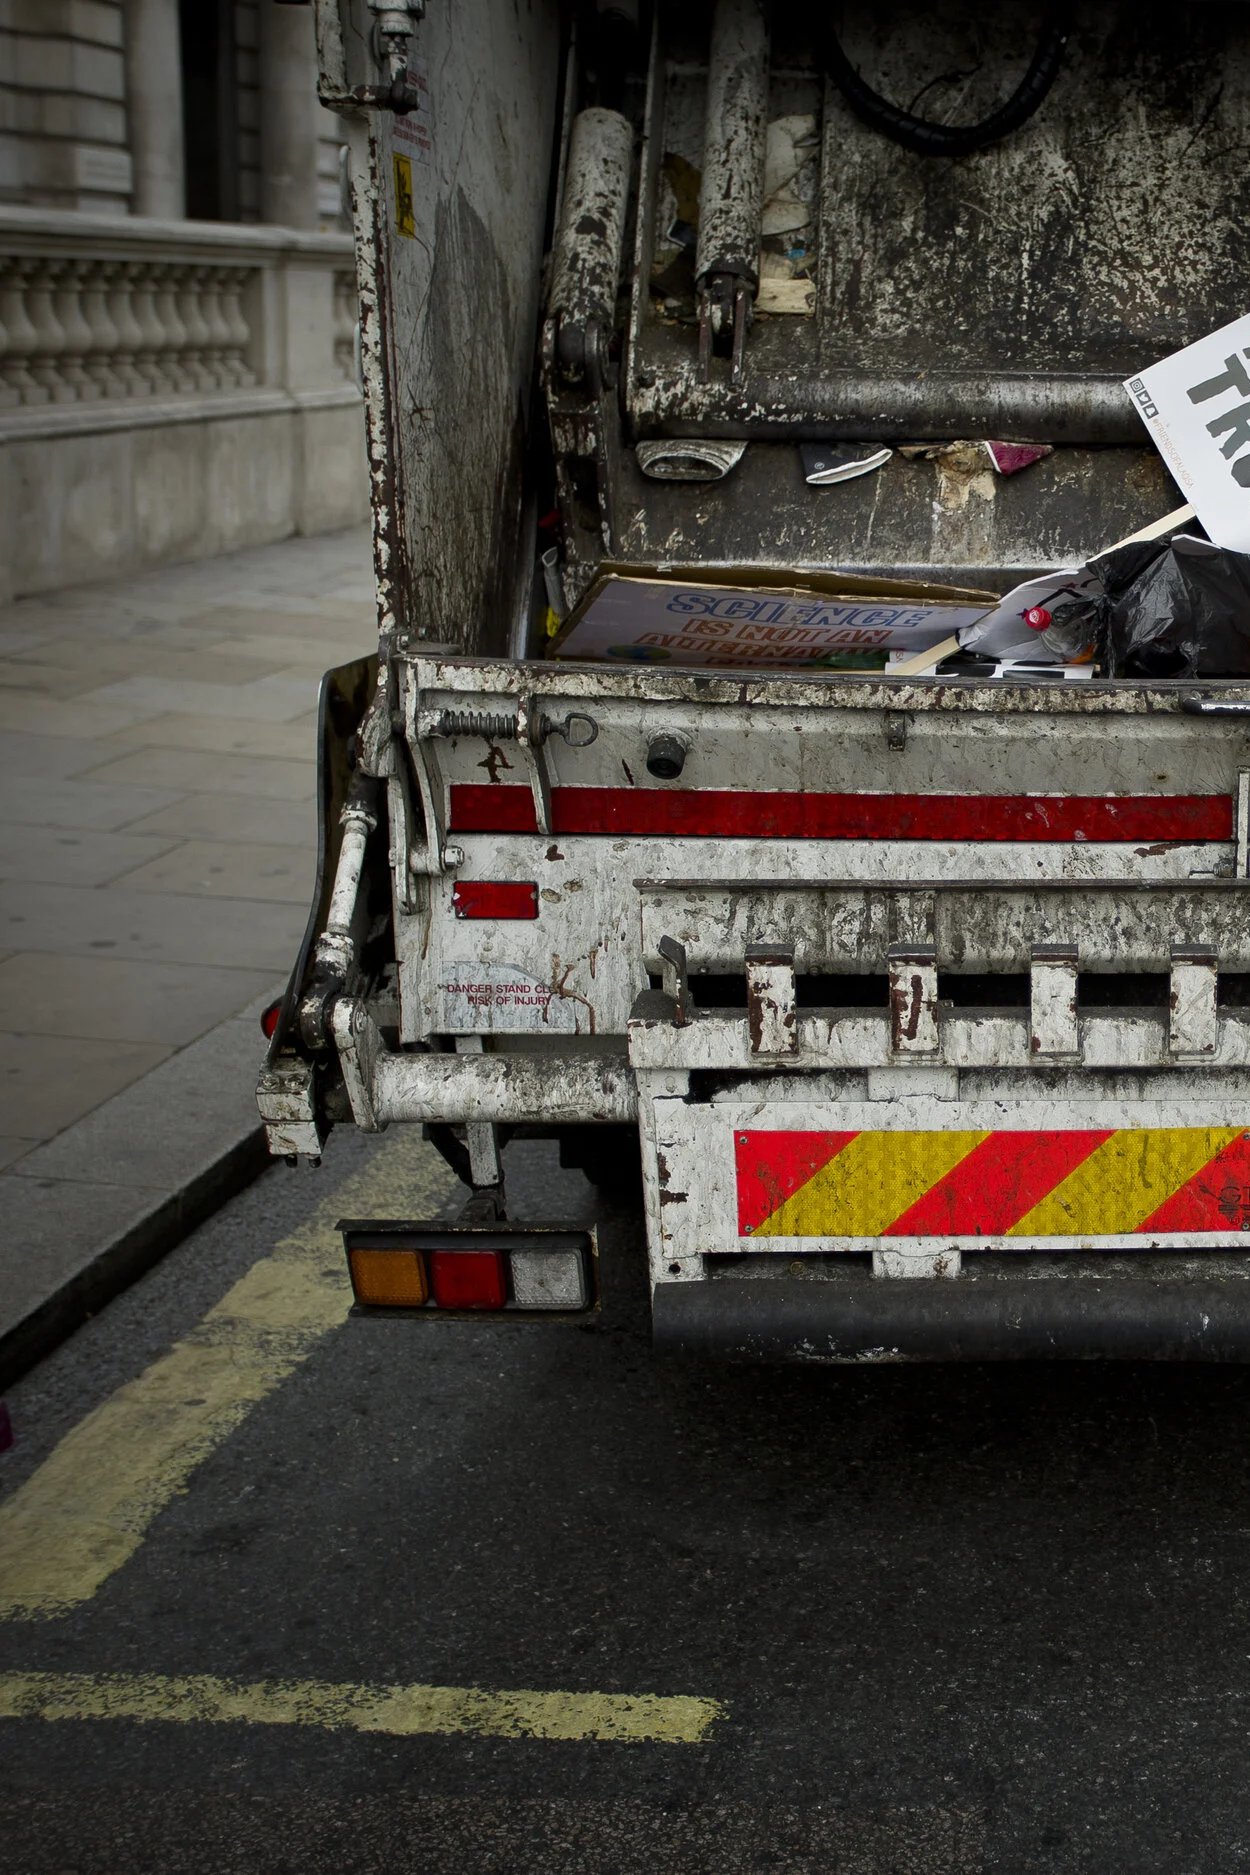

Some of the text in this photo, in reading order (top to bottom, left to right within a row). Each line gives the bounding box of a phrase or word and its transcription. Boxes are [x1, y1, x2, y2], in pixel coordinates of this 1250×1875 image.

[667, 593, 933, 628] SCIENCE
[681, 618, 894, 644] IS NOT AN
[447, 984, 492, 993] DANGER
[496, 984, 531, 993] STAND
[467, 996, 551, 1005] RISK OF INJURY
